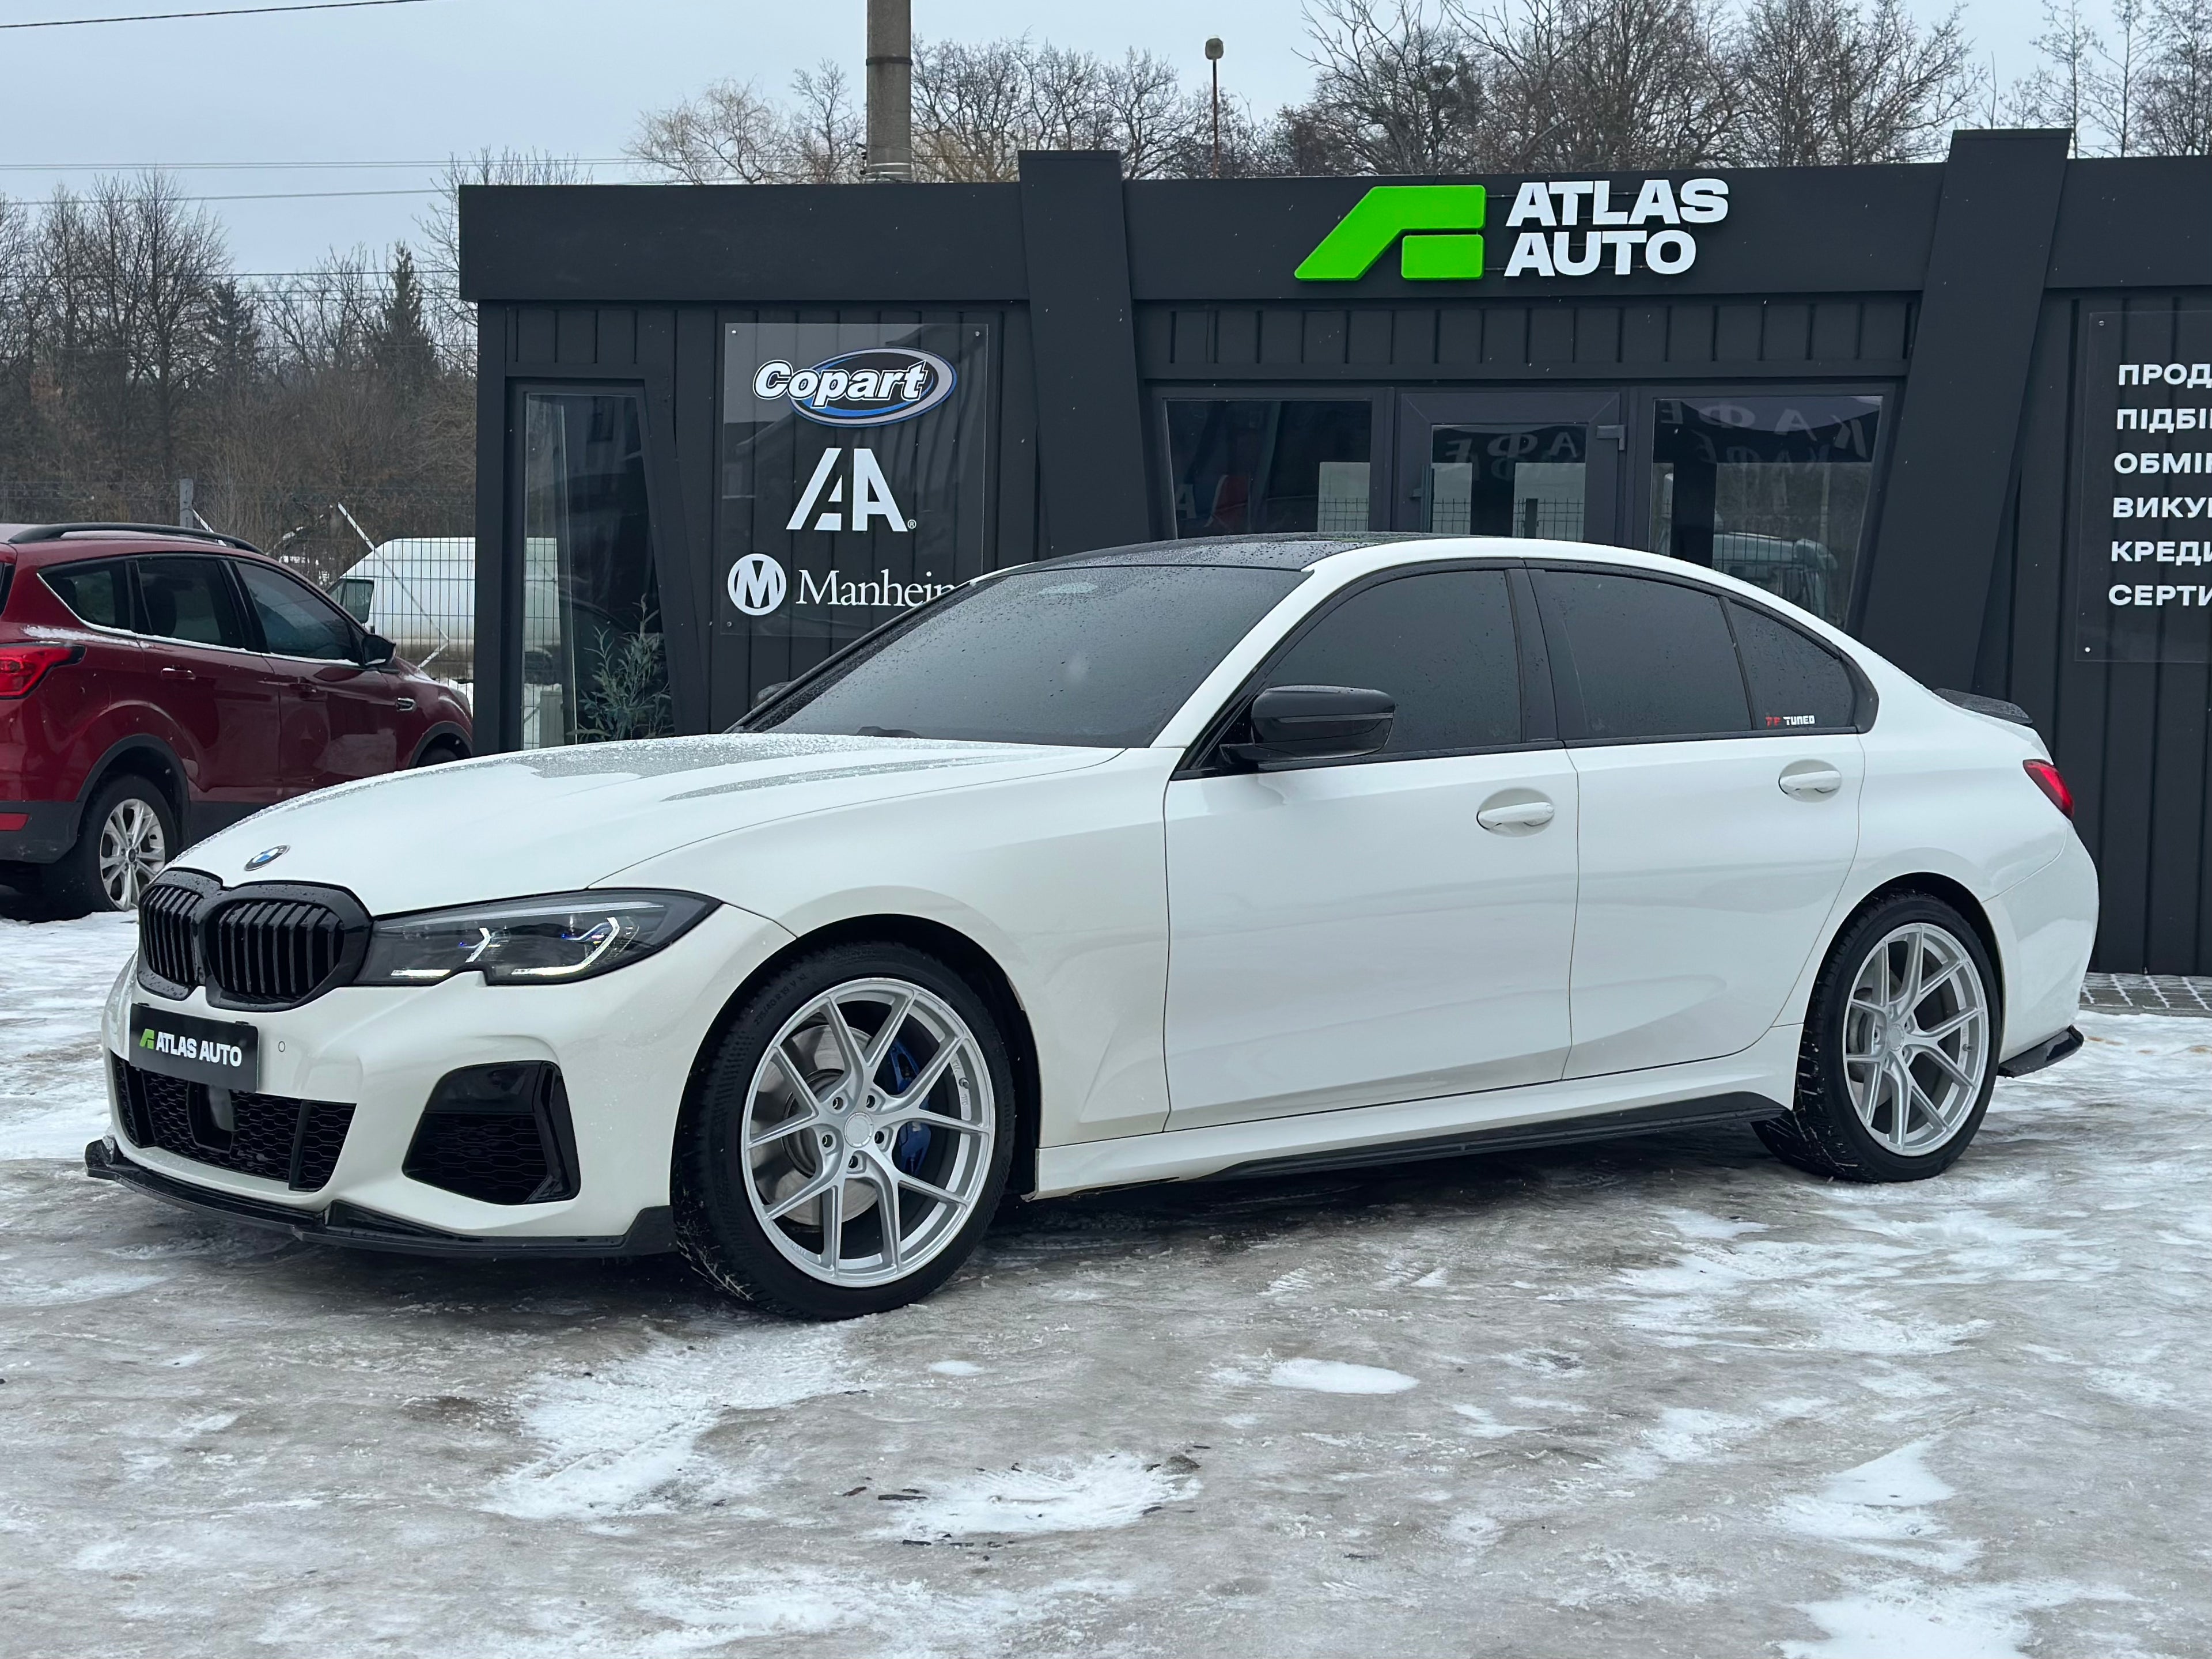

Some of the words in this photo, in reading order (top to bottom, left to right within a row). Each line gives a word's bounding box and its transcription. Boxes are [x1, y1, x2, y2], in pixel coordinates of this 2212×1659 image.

[1506, 178, 1729, 226] ATLAS
[1504, 230, 1696, 277] AUTO
[753, 359, 928, 408] Copart
[2116, 408, 2212, 433] ПІДБІ
[2113, 497, 2212, 518] ВИКУ
[1783, 715, 1816, 726] TUNED
[156, 1031, 197, 1059] ATLAS
[199, 1040, 242, 1067] AUTO
